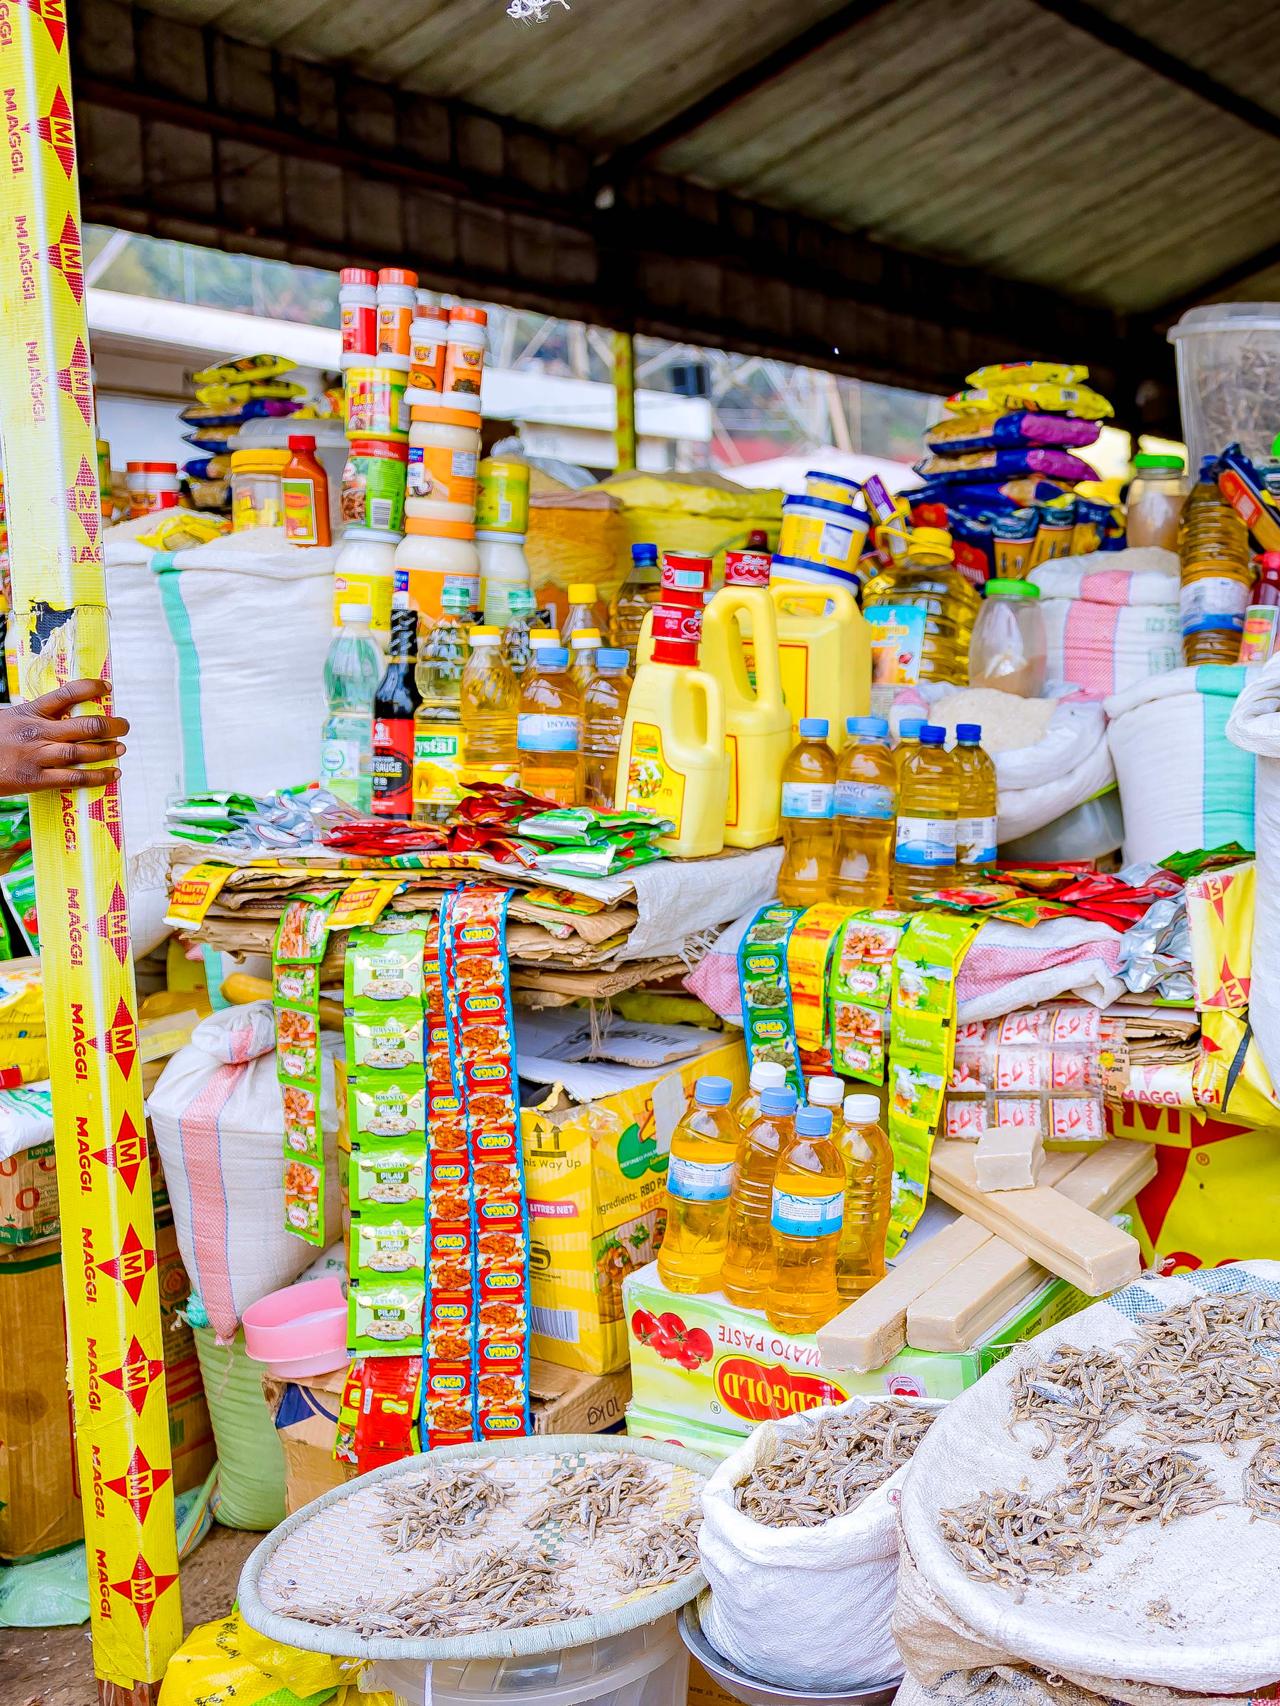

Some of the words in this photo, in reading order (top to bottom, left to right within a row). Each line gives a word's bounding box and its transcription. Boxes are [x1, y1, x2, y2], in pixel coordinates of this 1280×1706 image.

[0, 1, 13, 46] GGI
[4, 88, 25, 174] MAGGI
[54, 121, 73, 145] M
[14, 216, 36, 301] MAGGI
[64, 248, 82, 269] M
[26, 341, 46, 421] MAGGI
[74, 371, 91, 392] M
[67, 888, 84, 967] MAGGI
[110, 913, 128, 936] M
[749, 958, 776, 969] ONGA
[1226, 982, 1242, 1003] M
[115, 1027, 134, 1048] M
[756, 1022, 783, 1033] ONGA
[71, 1003, 88, 1081] MAGGI
[1121, 1090, 1181, 1104] MAGGI
[1192, 1087, 1221, 1104] GGI
[75, 1117, 92, 1194] MAGGI
[119, 1141, 138, 1161] M
[436, 1167, 461, 1178] ONGA
[524, 1158, 536, 1167] his
[539, 1159, 563, 1170] Way
[566, 1159, 581, 1169] Up
[639, 1183, 655, 1197] RBD
[530, 1204, 555, 1215] LITRES
[556, 1205, 574, 1215] NET
[436, 1236, 464, 1248] ONGA
[81, 1227, 97, 1303] MAGGI
[123, 1255, 143, 1275] M
[437, 1306, 465, 1318] ONGA
[718, 1325, 764, 1352] PASTE
[771, 1341, 822, 1367] MATO
[86, 1338, 102, 1412] MAGGI
[127, 1364, 146, 1387] M
[433, 1376, 462, 1389] ONGA
[91, 1445, 106, 1518] MAGGI
[130, 1474, 150, 1496] M
[95, 1549, 112, 1620] MAGGI
[134, 1580, 153, 1602] M
